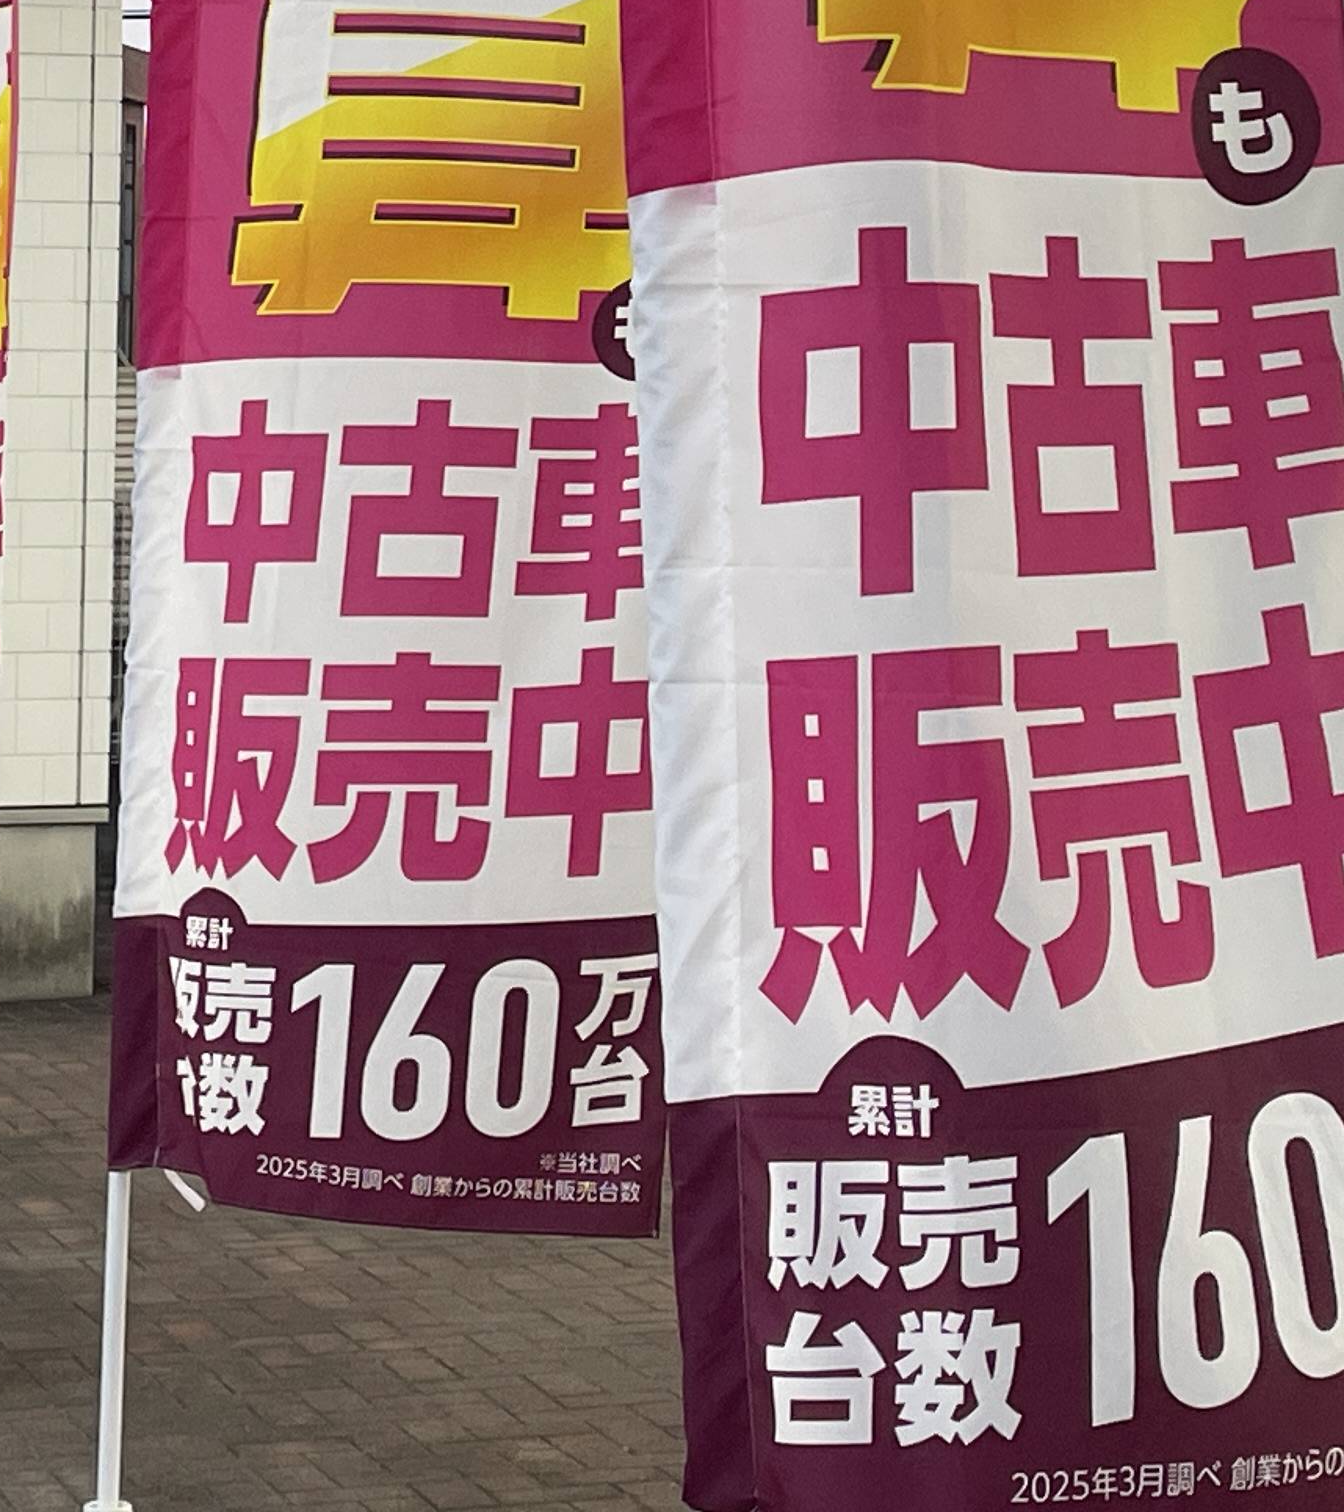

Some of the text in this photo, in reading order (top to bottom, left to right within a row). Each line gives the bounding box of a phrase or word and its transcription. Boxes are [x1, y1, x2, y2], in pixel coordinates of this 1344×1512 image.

[1209, 81, 1294, 174] も
[184, 399, 644, 623] 中古車
[164, 646, 652, 884] 販売中
[186, 916, 233, 950] 累計
[848, 1085, 940, 1138] 累計
[256, 1154, 641, 1204] 2025年3月調べ 創業からの累計販売台数
[766, 1156, 1020, 1290] 販売
[765, 1309, 1023, 1446] 台数
[1011, 1461, 1221, 1504] 2025年3月調べ
